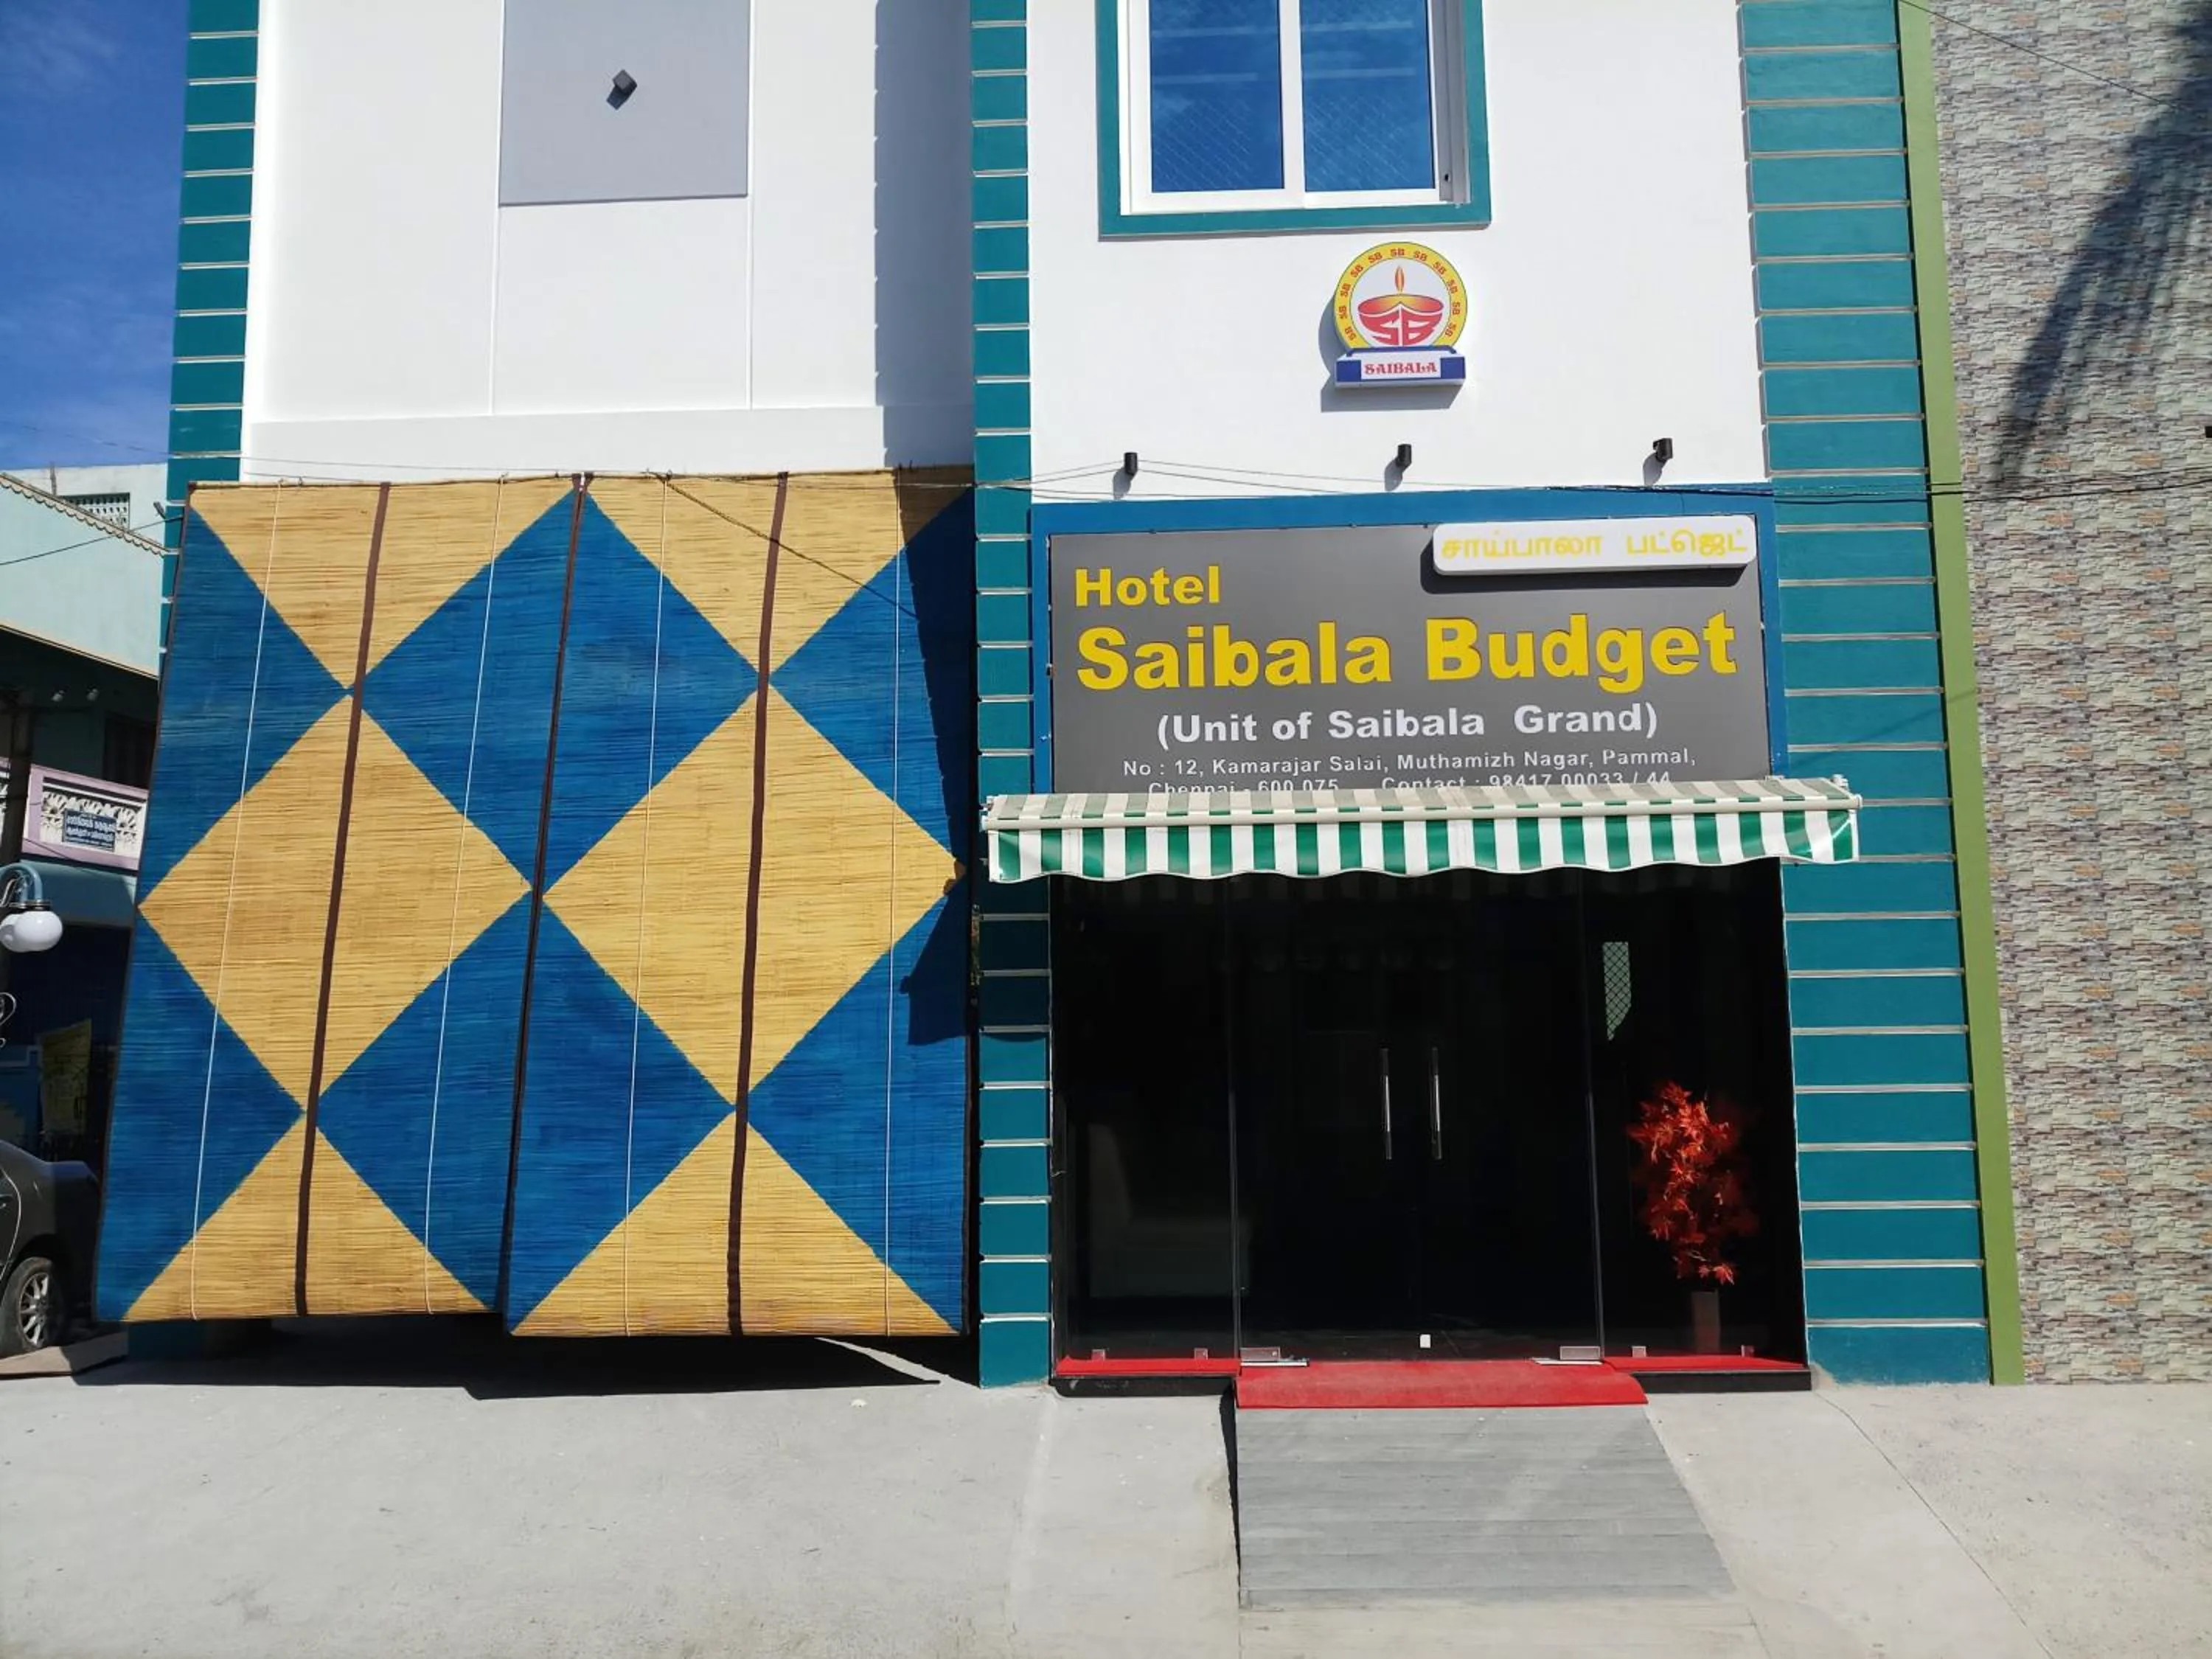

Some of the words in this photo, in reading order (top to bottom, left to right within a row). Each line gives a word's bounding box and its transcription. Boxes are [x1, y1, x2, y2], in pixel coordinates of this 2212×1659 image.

[1365, 363, 1437, 375] SAIBALA
[1441, 531, 1603, 559] சாய்பாலா
[1627, 528, 1747, 557] பட்ஜெட்
[1075, 565, 1220, 607] Hotel
[1077, 621, 1392, 691] Saibala
[1426, 610, 1738, 694] Budget
[1158, 713, 1257, 751] (Unit
[1272, 712, 1312, 740] of
[1328, 708, 1484, 740] Saibala
[1513, 702, 1658, 739] Grand)
[1123, 760, 1151, 776] No
[1175, 759, 1204, 777] 12,
[1212, 758, 1321, 776] Kamarajar
[1329, 756, 1389, 773] Salai,
[1397, 751, 1514, 769] Muthamizh
[1524, 751, 1594, 770] Nagar,
[1602, 748, 1696, 766] Pammal,
[1258, 779, 1293, 791] 600
[1302, 779, 1339, 790] 075
[1489, 774, 1552, 786] 98417
